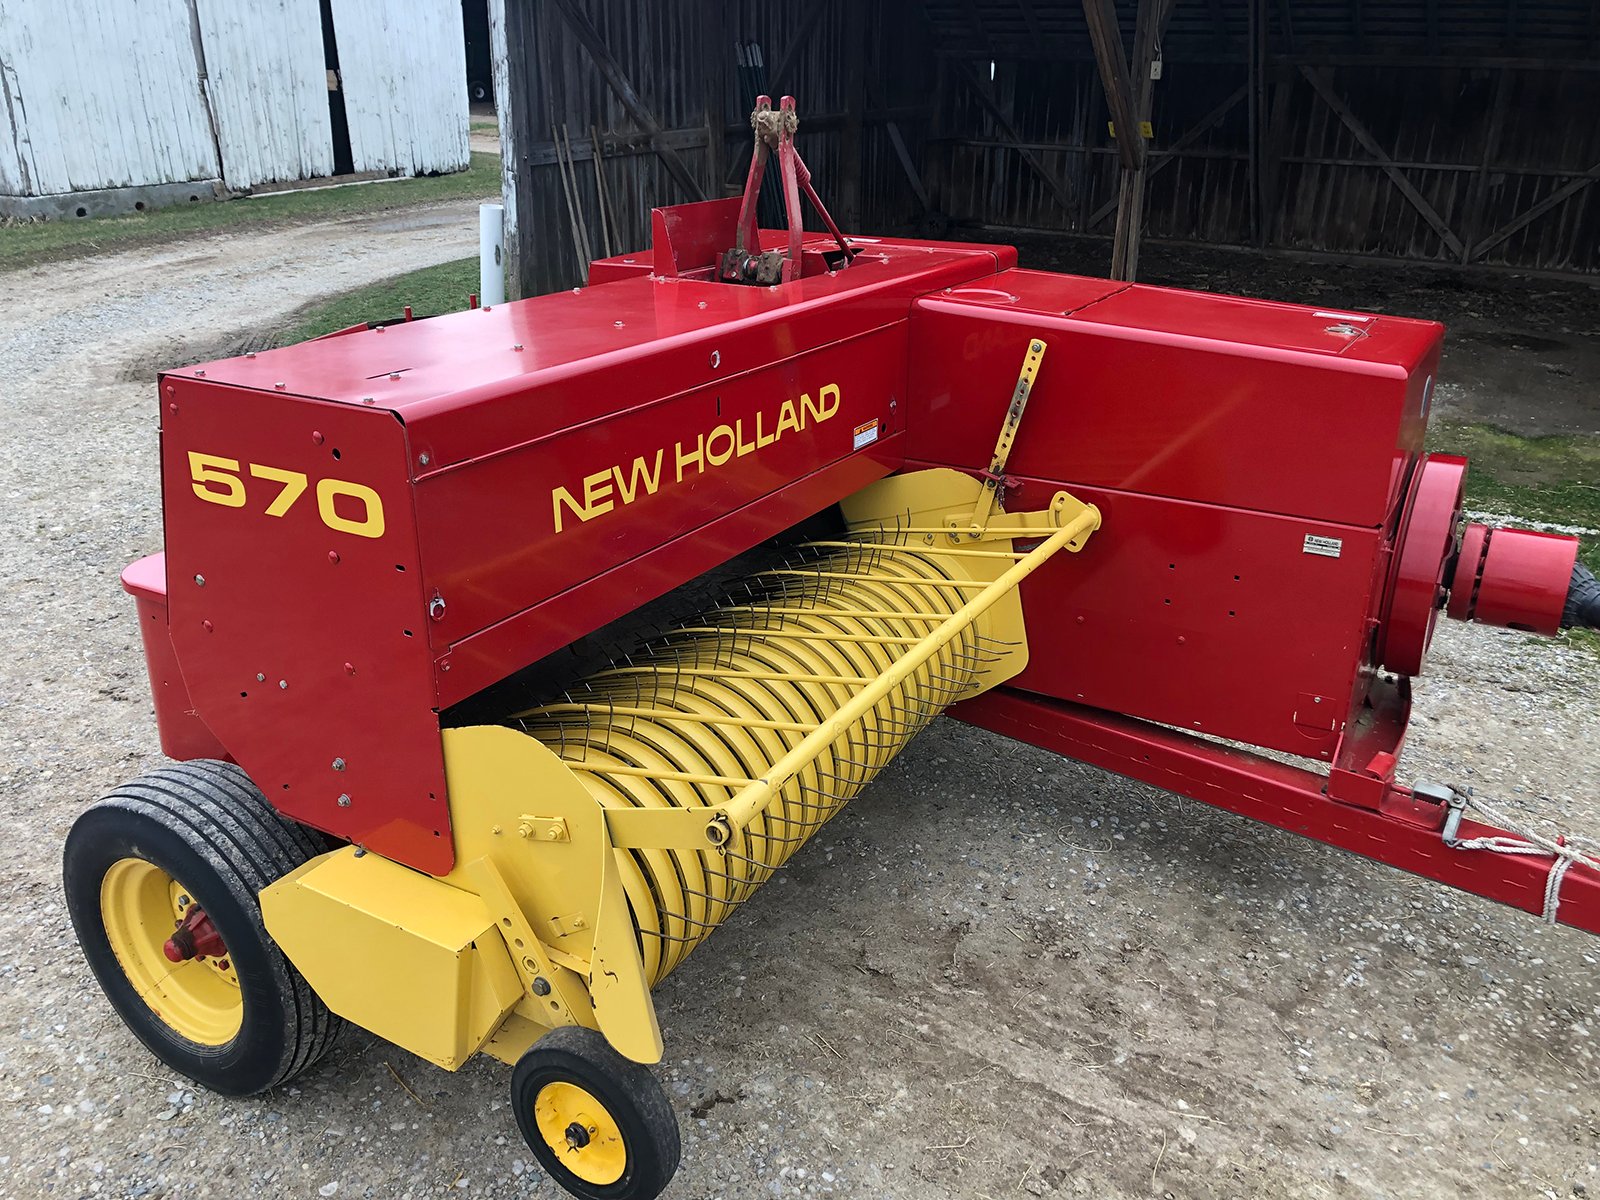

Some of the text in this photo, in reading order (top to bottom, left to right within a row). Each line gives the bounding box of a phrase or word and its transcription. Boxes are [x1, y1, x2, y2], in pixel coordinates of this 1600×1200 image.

[188, 451, 385, 538] 570
[551, 383, 841, 533] NEW HOLLAND
